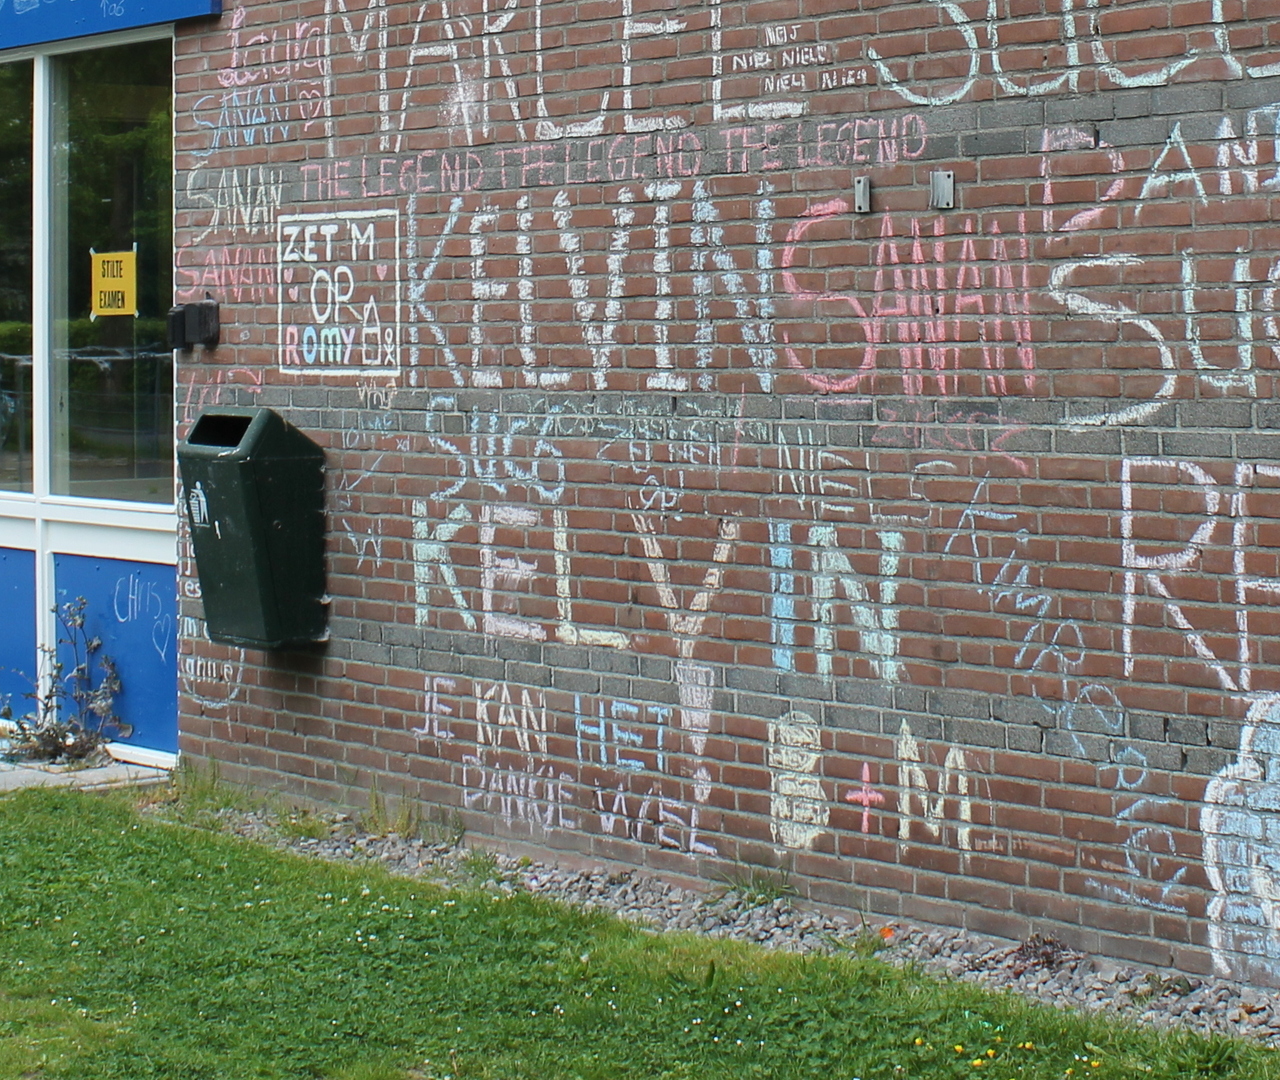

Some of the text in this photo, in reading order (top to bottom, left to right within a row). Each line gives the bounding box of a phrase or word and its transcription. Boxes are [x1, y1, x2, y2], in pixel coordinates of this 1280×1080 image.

[300, 163, 350, 201] THE
[361, 151, 484, 197] LEGEND
[565, 131, 702, 186] LEGEND
[797, 115, 926, 168] LEGEND
[283, 223, 332, 262] ZET
[102, 260, 123, 278] STILTE
[100, 291, 125, 309] EXAMEN
[474, 682, 548, 762] KAN
